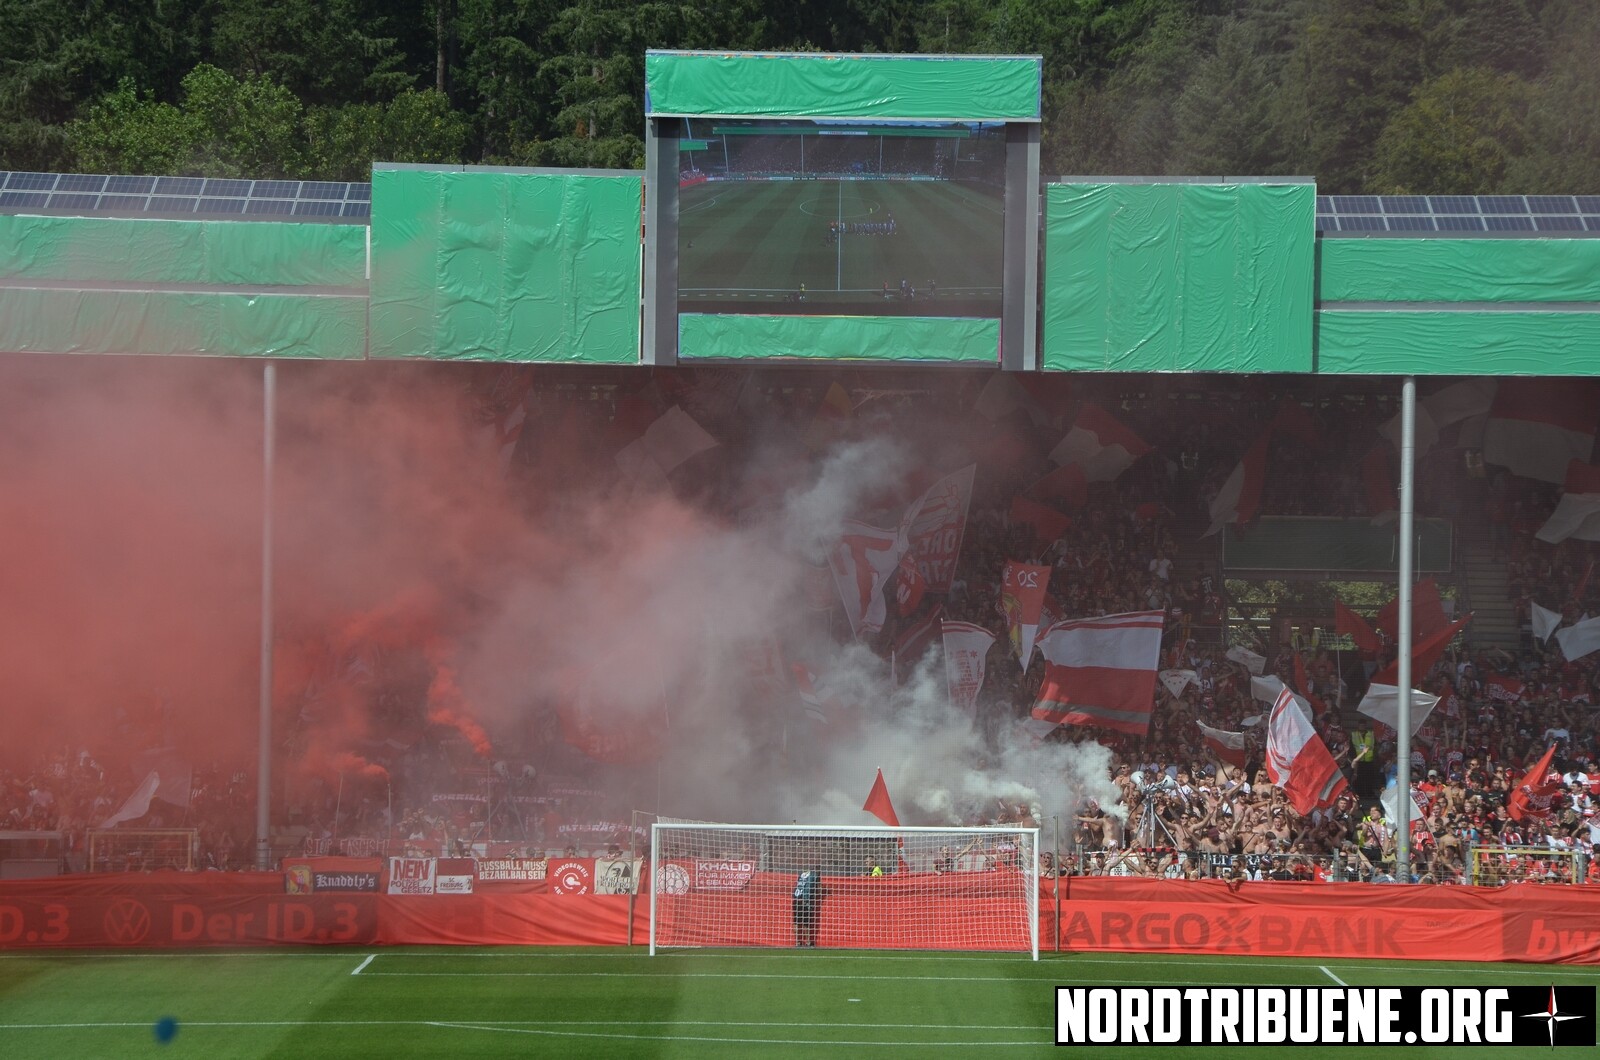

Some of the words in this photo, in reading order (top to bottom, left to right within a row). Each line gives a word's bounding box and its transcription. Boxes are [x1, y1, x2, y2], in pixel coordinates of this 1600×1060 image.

[305, 838, 333, 855] STOP
[394, 859, 430, 880] NEIN
[479, 861, 521, 871] FUSSBALL
[522, 861, 547, 871] MUSS
[553, 862, 589, 878] VIDEOBEWEIS
[699, 862, 752, 872] KHALID
[315, 874, 375, 890] Knaddly's
[479, 871, 527, 880] BEZAHLBAR
[528, 871, 546, 880] SEIN
[719, 872, 752, 880] IMMER
[401, 886, 432, 894] GESETZ
[172, 905, 255, 941] Der
[268, 902, 359, 941] ID.3
